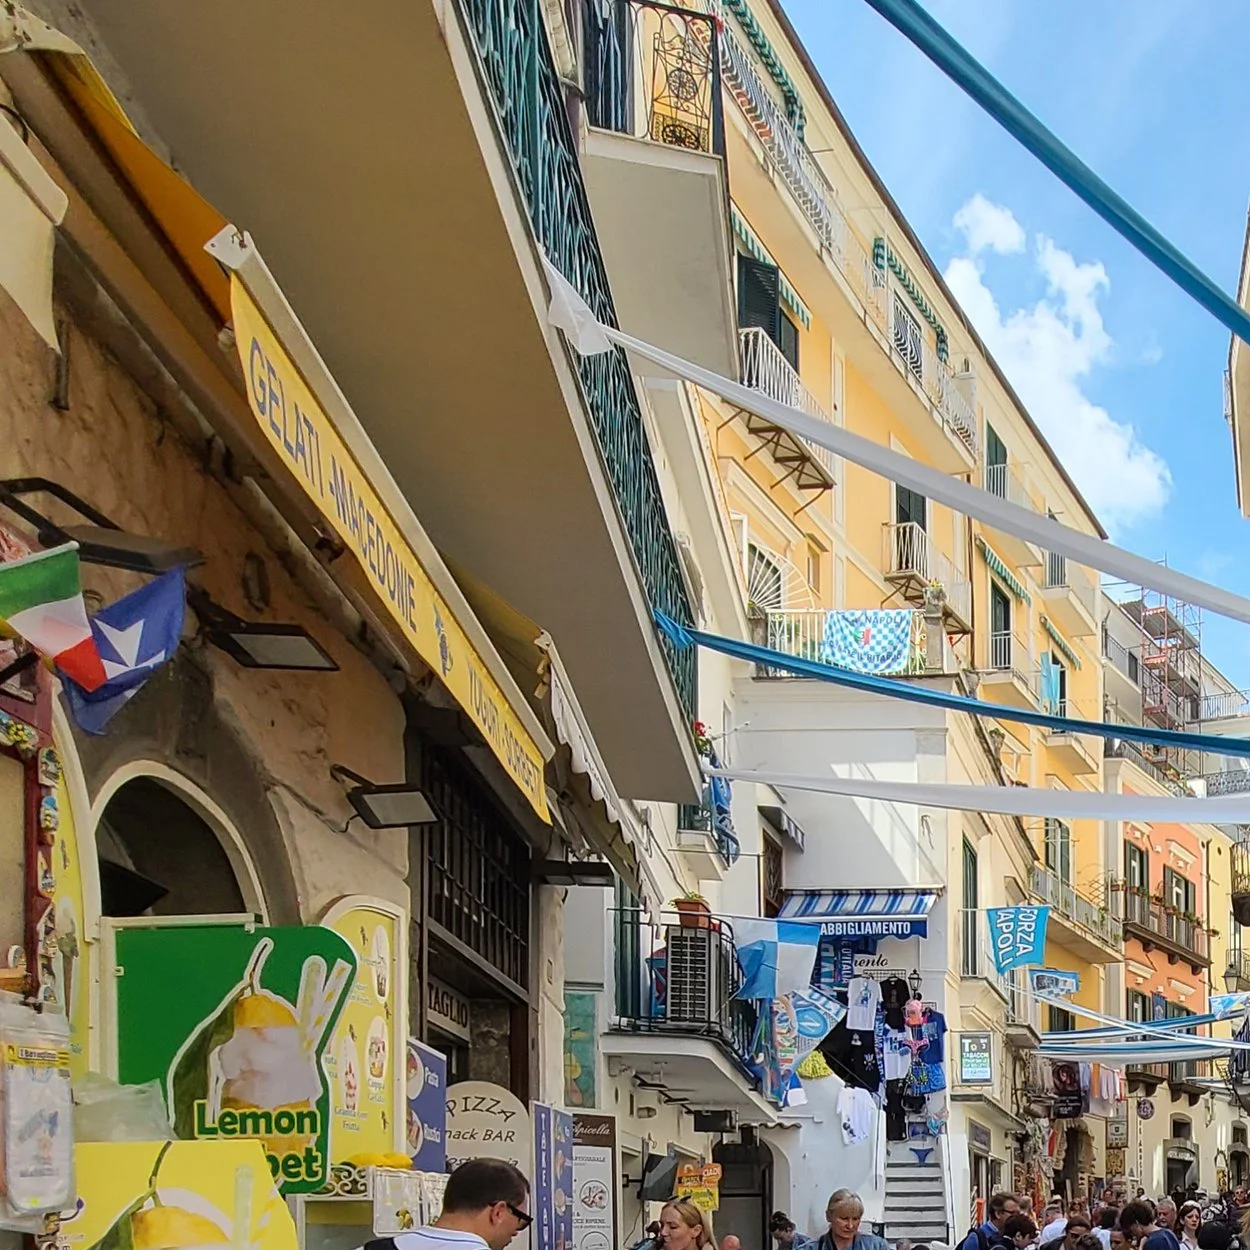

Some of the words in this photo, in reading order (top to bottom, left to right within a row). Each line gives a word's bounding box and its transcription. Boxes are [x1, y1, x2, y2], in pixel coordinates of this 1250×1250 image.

[250, 336, 325, 499] GELATI
[820, 921, 911, 936] ABBIGLIAMENTO
[427, 982, 468, 1029] TAGLIO
[197, 1099, 318, 1135] Lemon
[446, 1095, 516, 1123] PIZZA
[445, 1127, 479, 1141] nack
[482, 1129, 516, 1143] BAR
